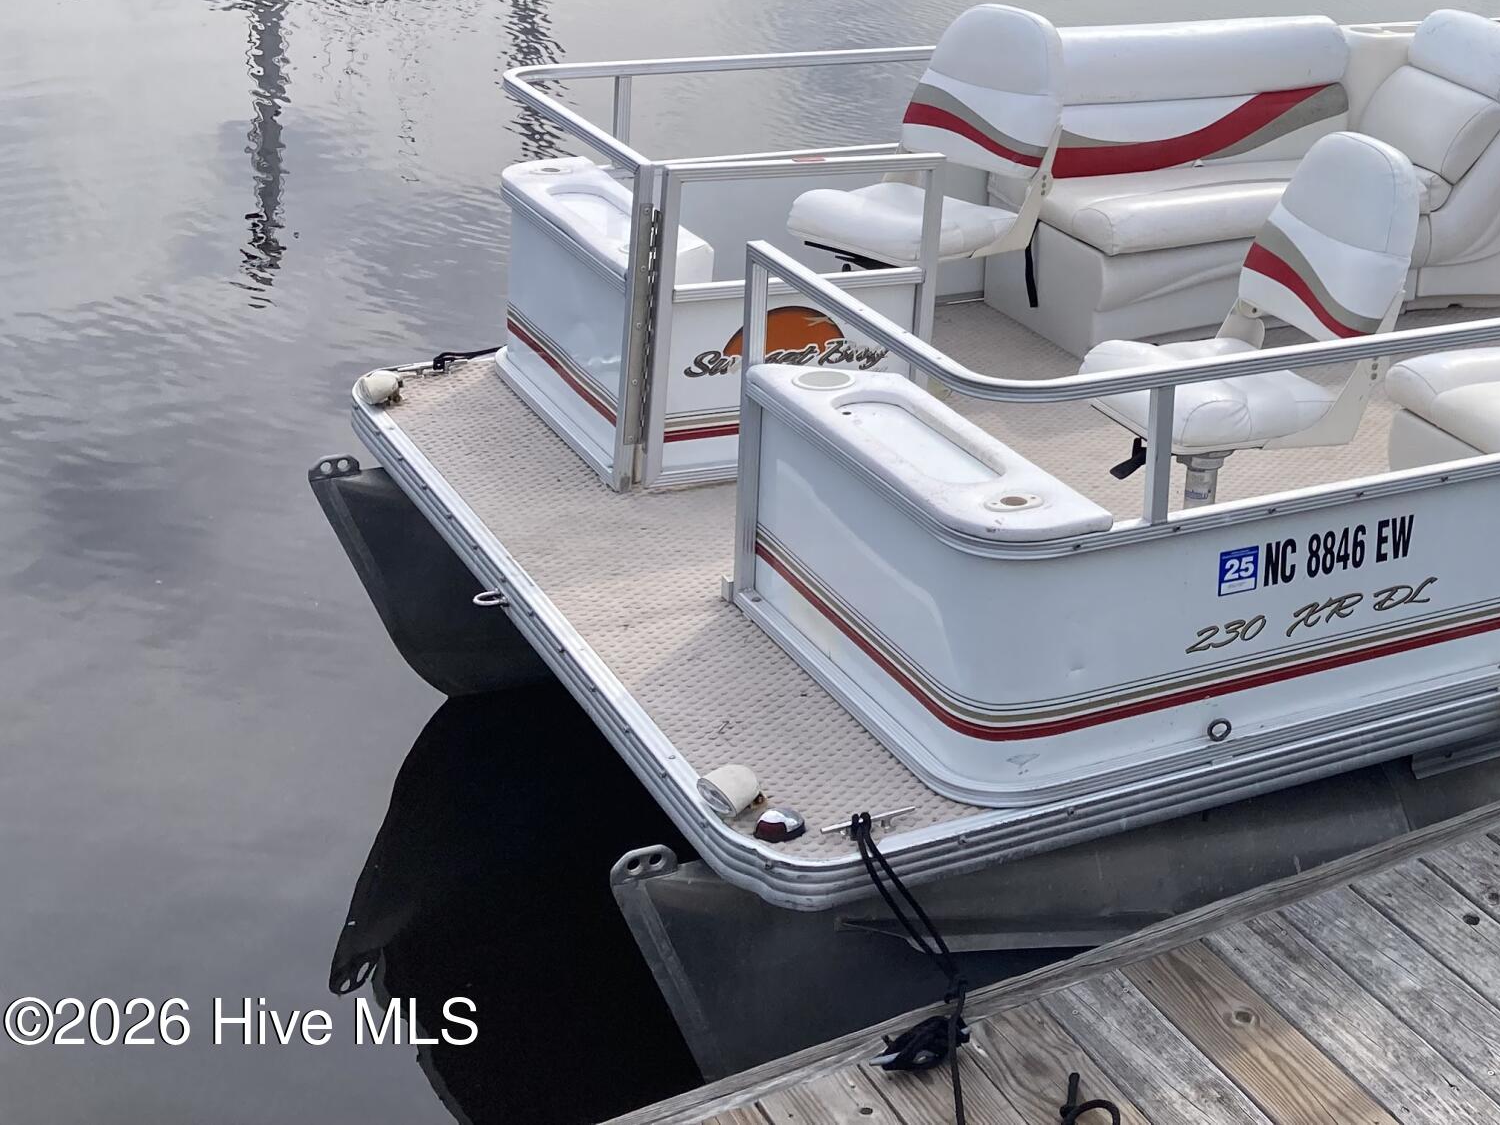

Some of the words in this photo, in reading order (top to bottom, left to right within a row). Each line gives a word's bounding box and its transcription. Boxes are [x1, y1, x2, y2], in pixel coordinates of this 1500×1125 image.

[684, 343, 819, 378] Suset
[1223, 555, 1255, 581] 25
[1263, 538, 1297, 587] NC
[1306, 524, 1367, 578] 8846
[1375, 514, 1415, 563] EW
[1185, 615, 1267, 654] 230
[1373, 577, 1438, 612] DL
